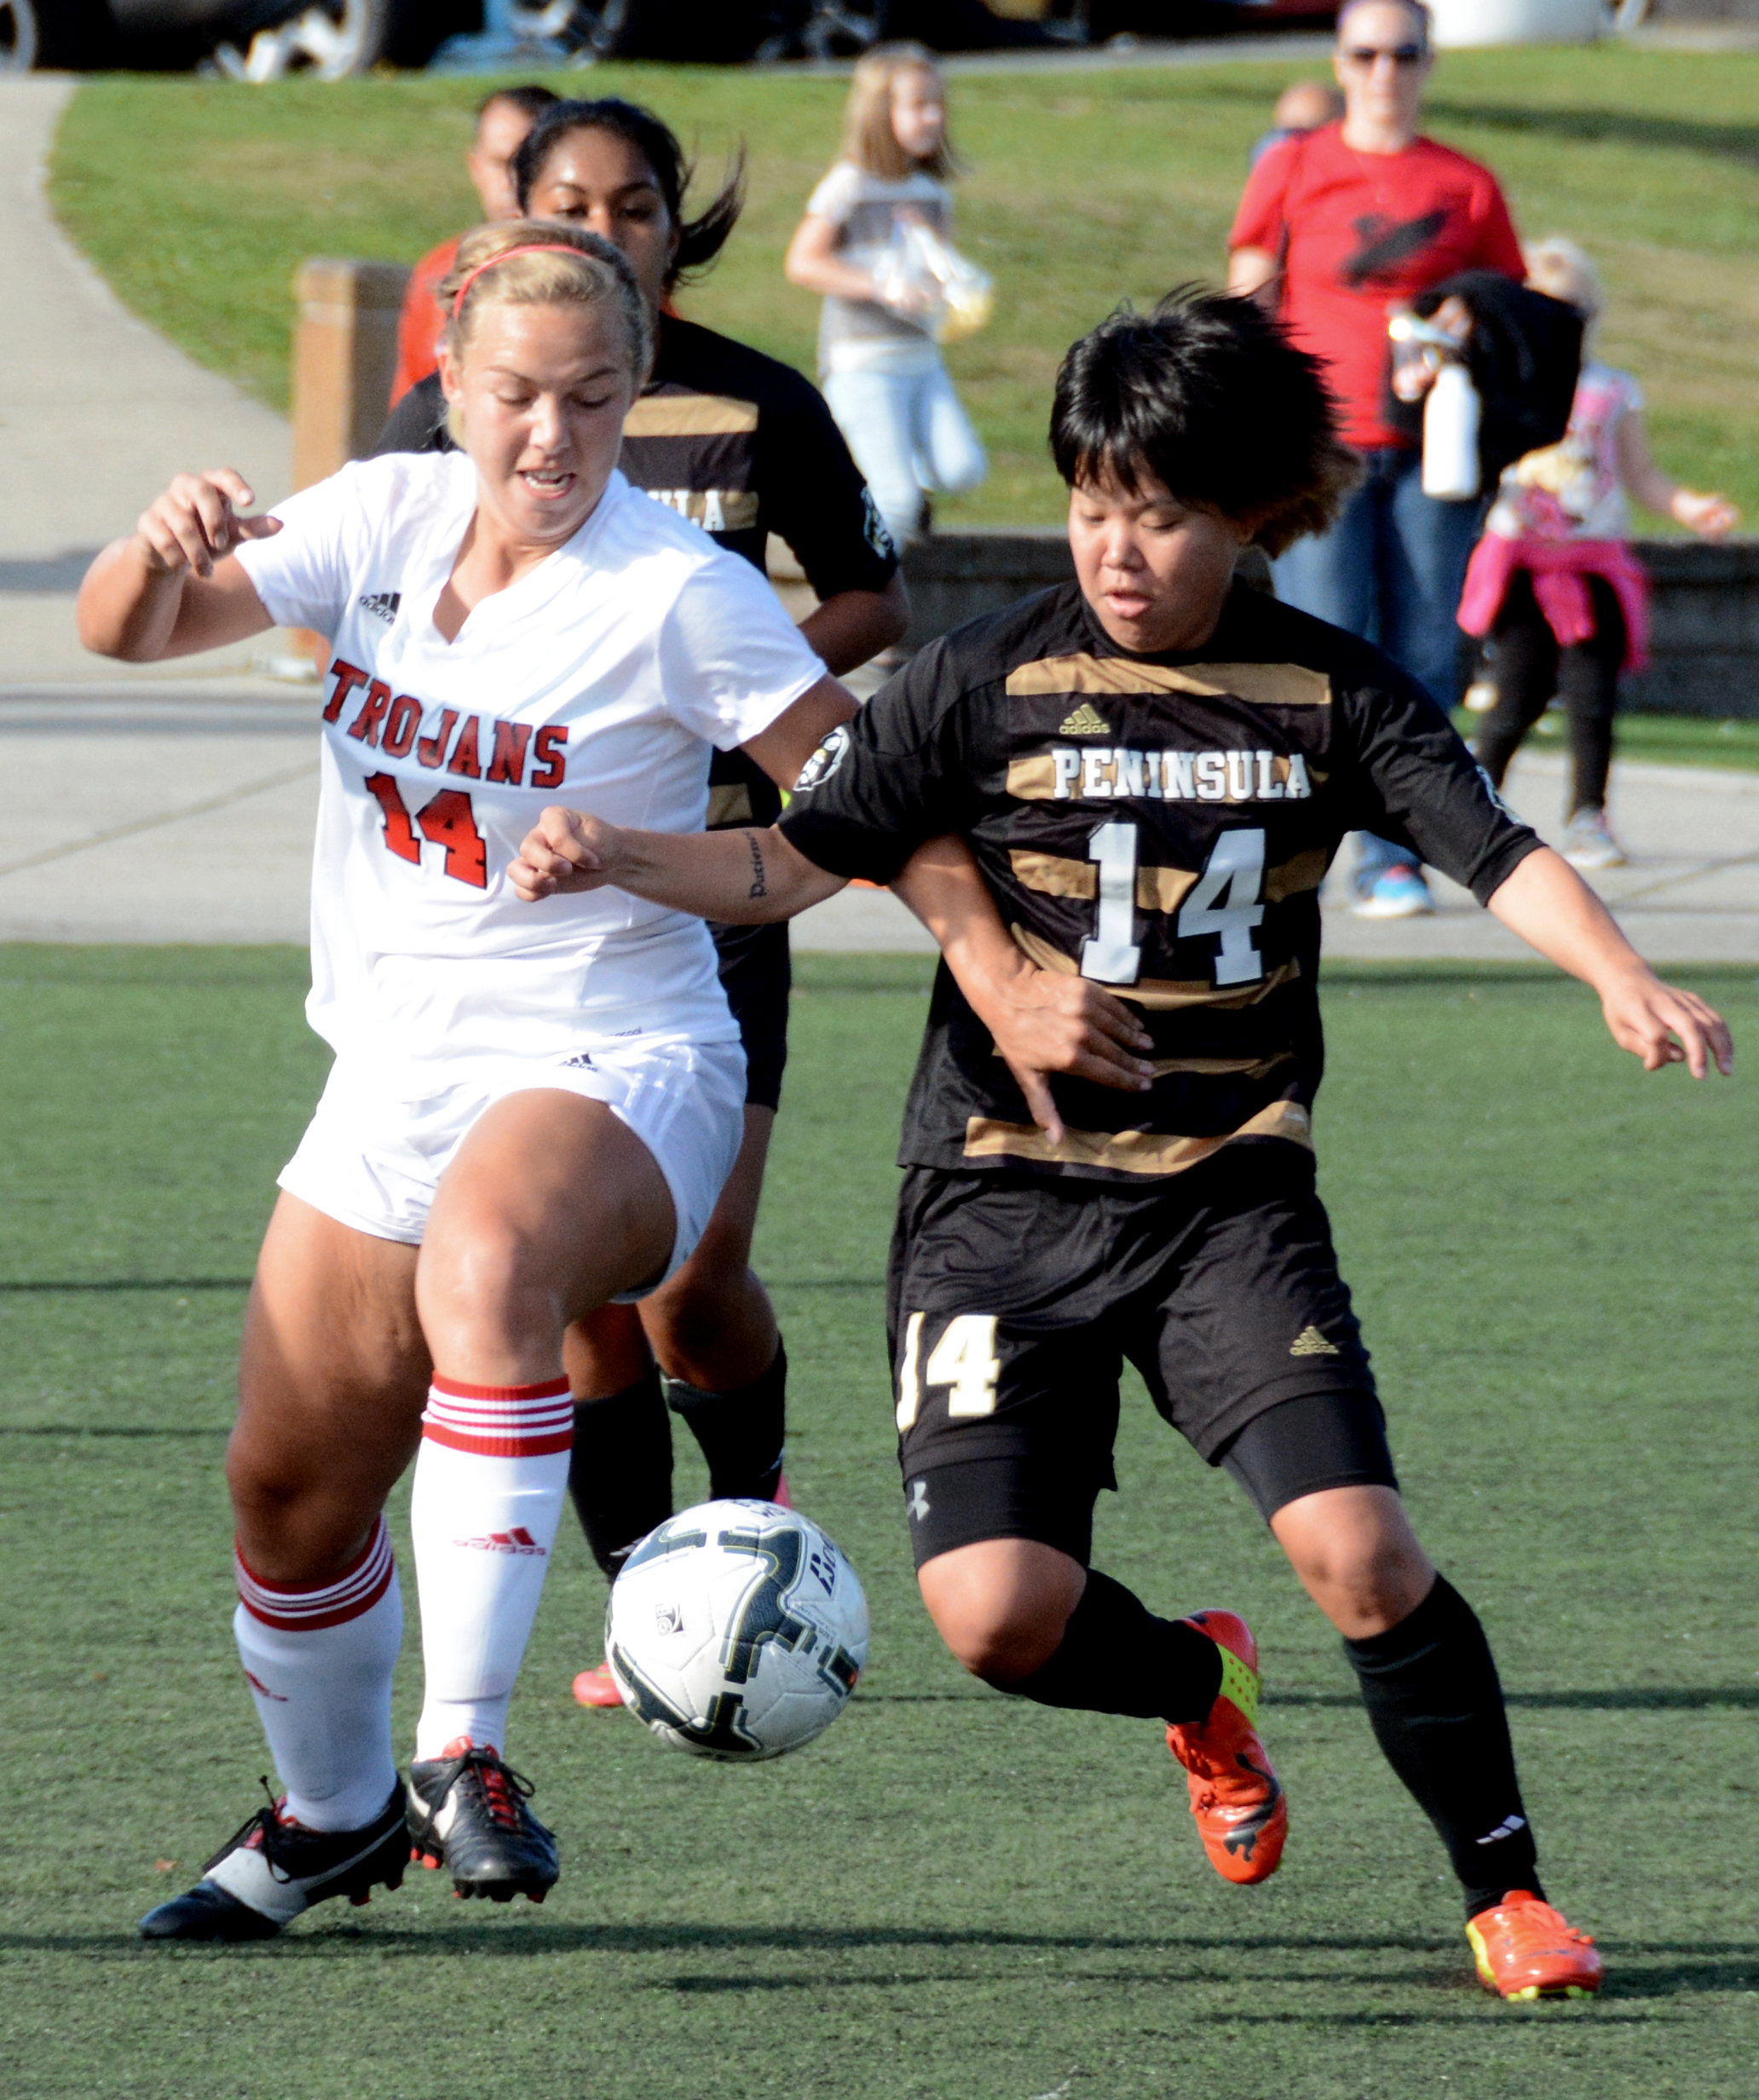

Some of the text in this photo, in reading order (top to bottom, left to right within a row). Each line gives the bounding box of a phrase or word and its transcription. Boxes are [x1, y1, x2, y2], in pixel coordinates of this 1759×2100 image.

[648, 489, 725, 530] LA
[322, 658, 569, 789] TROJANS
[1059, 723, 1110, 735] adidas
[1052, 748, 1312, 799] PENINSULA
[365, 770, 487, 890] 14
[1080, 822, 1266, 985] 14
[897, 1312, 1001, 1434] 14
[453, 1539, 546, 1555] adidas
